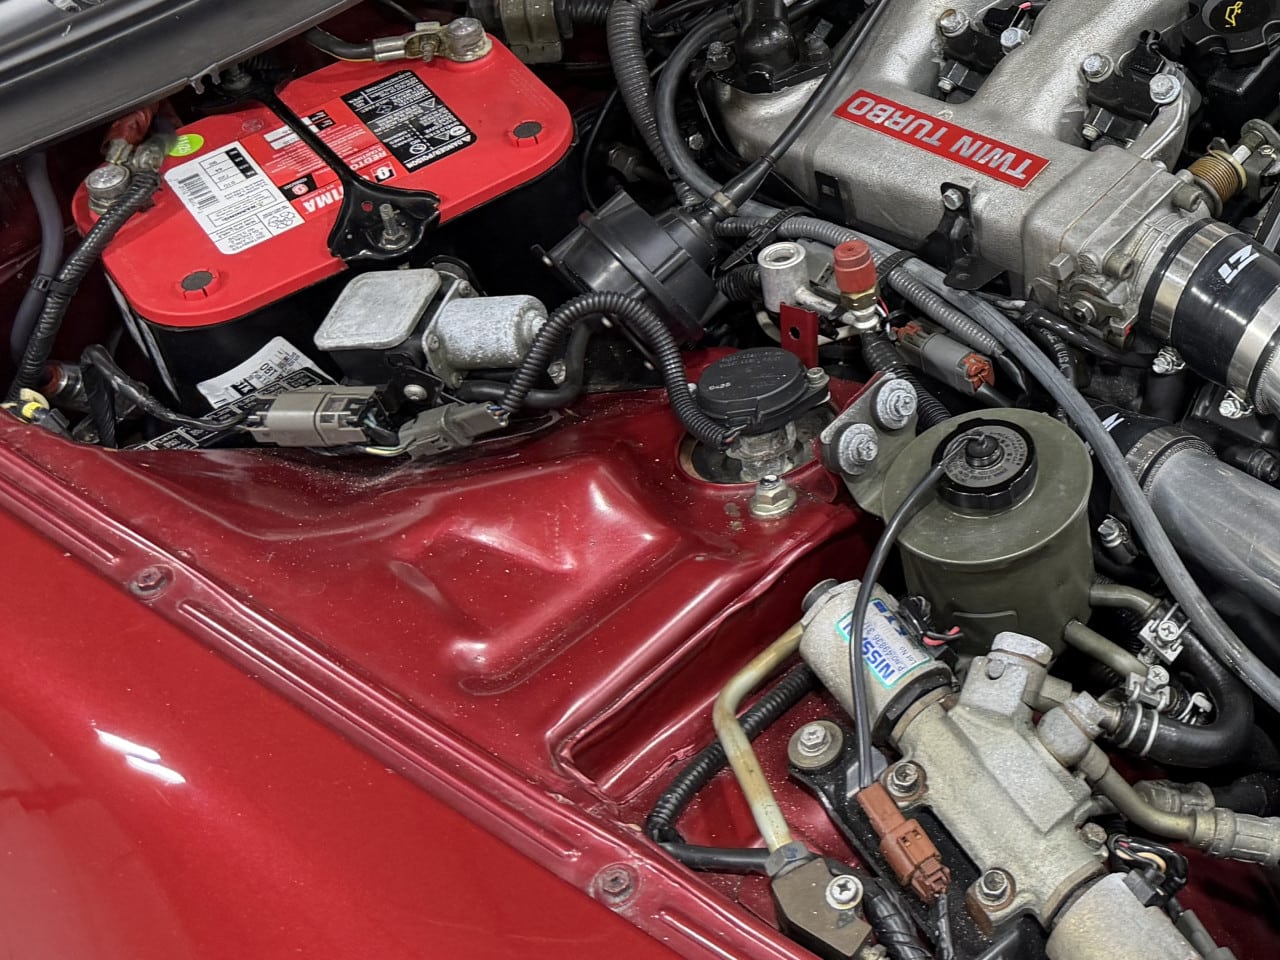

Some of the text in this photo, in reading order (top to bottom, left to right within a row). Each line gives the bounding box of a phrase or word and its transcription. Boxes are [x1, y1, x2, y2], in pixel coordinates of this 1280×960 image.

[845, 93, 1034, 181] TWIN TURBO
[348, 150, 388, 171] REDTO
[1217, 245, 1259, 284] Z1
